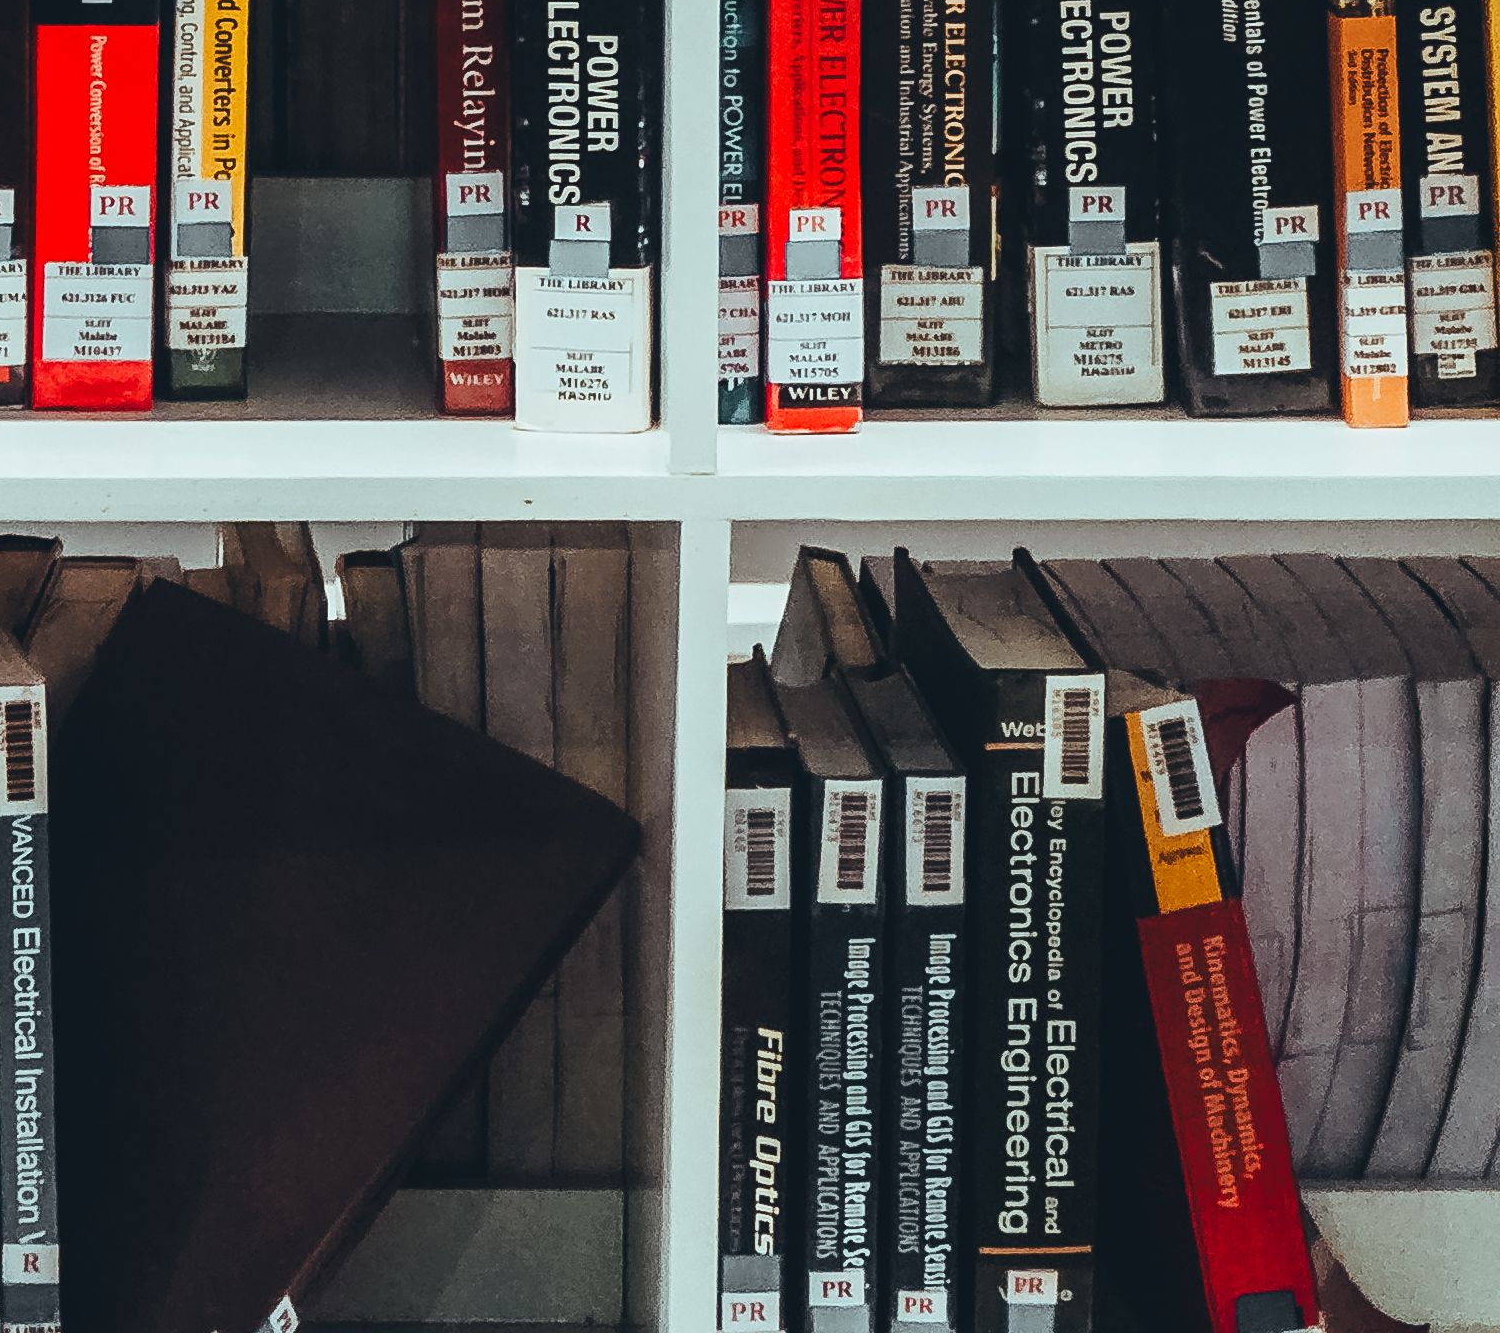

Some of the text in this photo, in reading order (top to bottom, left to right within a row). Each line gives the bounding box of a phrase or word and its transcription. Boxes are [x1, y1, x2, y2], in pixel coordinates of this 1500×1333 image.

[211, 17, 241, 132] Converters
[586, 35, 619, 153] POWER
[1098, 11, 1133, 129] POWER
[1419, 7, 1462, 124] SYSTEM
[449, 372, 504, 387] WILEY
[787, 386, 852, 403] WILEY
[999, 772, 1040, 1235] Electronics Engineering
[12, 927, 44, 1225] Electrical Installation
[1045, 1021, 1077, 1235] Electrical and
[749, 1028, 784, 1257] Fibre Optics
